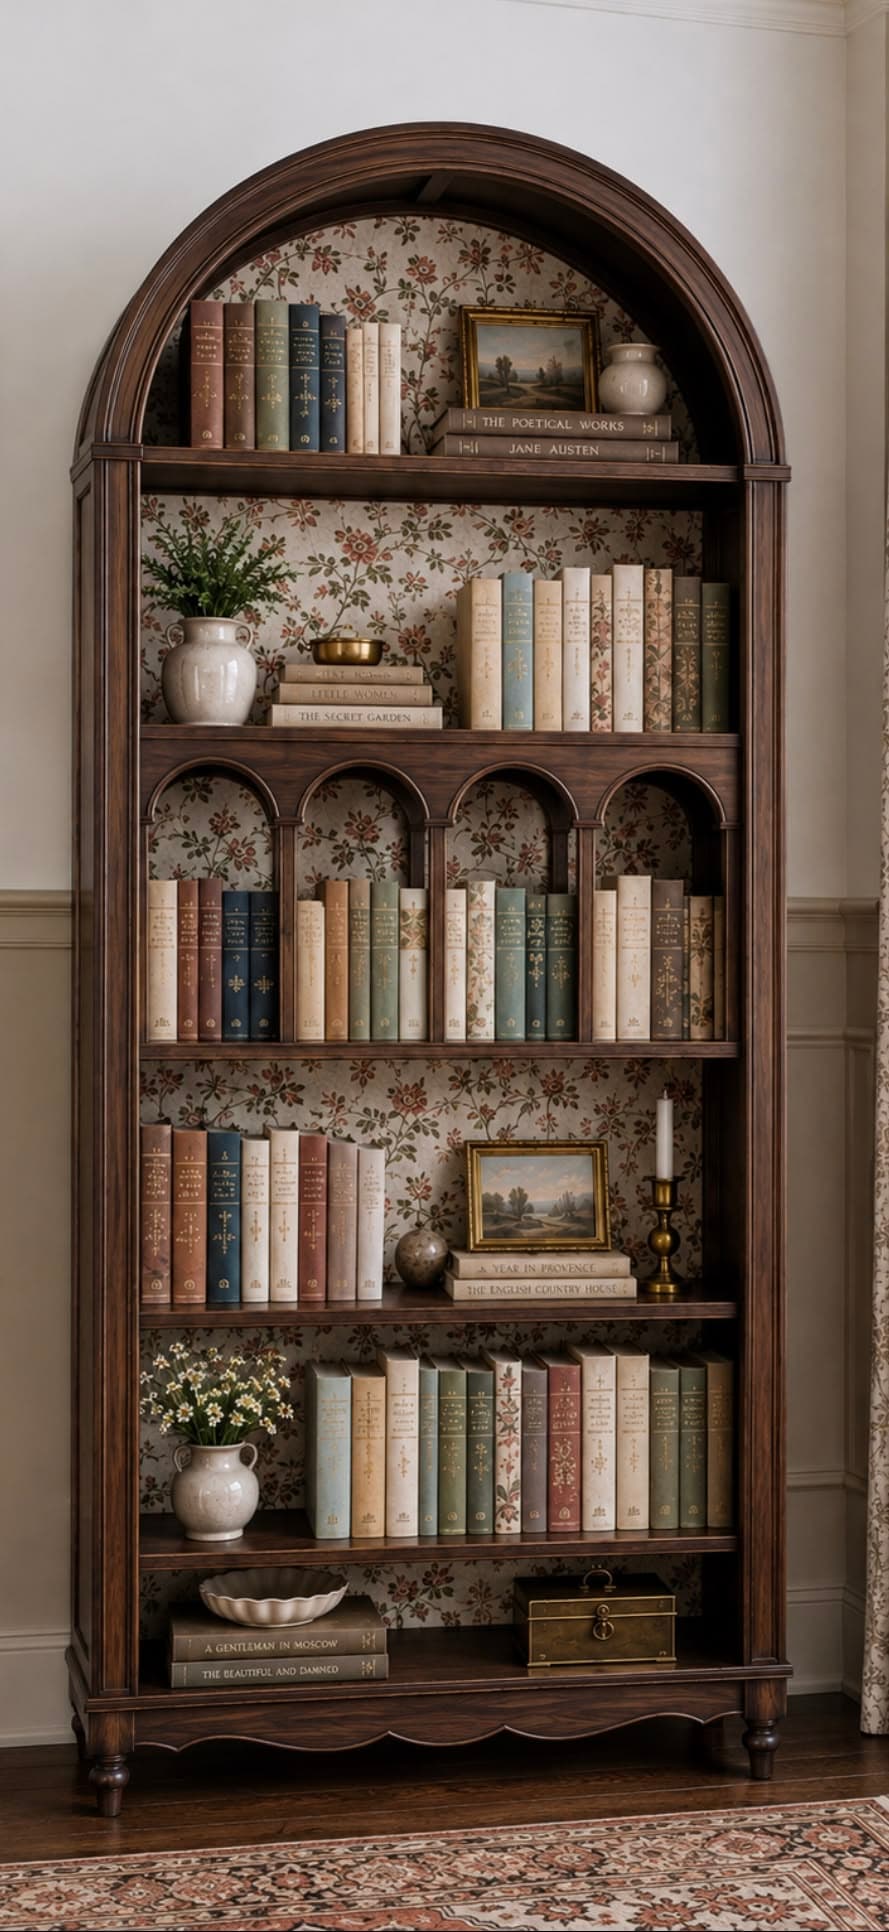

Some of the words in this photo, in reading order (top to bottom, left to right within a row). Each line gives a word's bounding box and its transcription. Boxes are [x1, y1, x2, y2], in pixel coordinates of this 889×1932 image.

[482, 416, 505, 428] THE
[512, 418, 573, 431] POETICAL
[580, 420, 625, 432] WORKS
[508, 444, 541, 455] JANE
[550, 445, 600, 456] AUSTEN
[298, 711, 320, 721] THE
[324, 712, 363, 722] SECRET
[367, 713, 411, 723] GARDEN
[492, 1263, 520, 1273] YEAR
[524, 1263, 535, 1273] IN
[541, 1263, 597, 1273] PROVENCE
[466, 1285, 486, 1296] THE
[489, 1284, 531, 1295] ENGLISH
[535, 1284, 580, 1294] COUNTRY
[585, 1284, 617, 1294] HOUSE
[216, 1642, 275, 1653] GENTLEMAN
[280, 1641, 290, 1649] IN
[295, 1639, 338, 1649] MOSCOW
[203, 1670, 220, 1679] THE
[224, 1668, 272, 1678] BEAUTIFUL
[276, 1667, 296, 1676] AND
[299, 1665, 339, 1675] DAMNED
